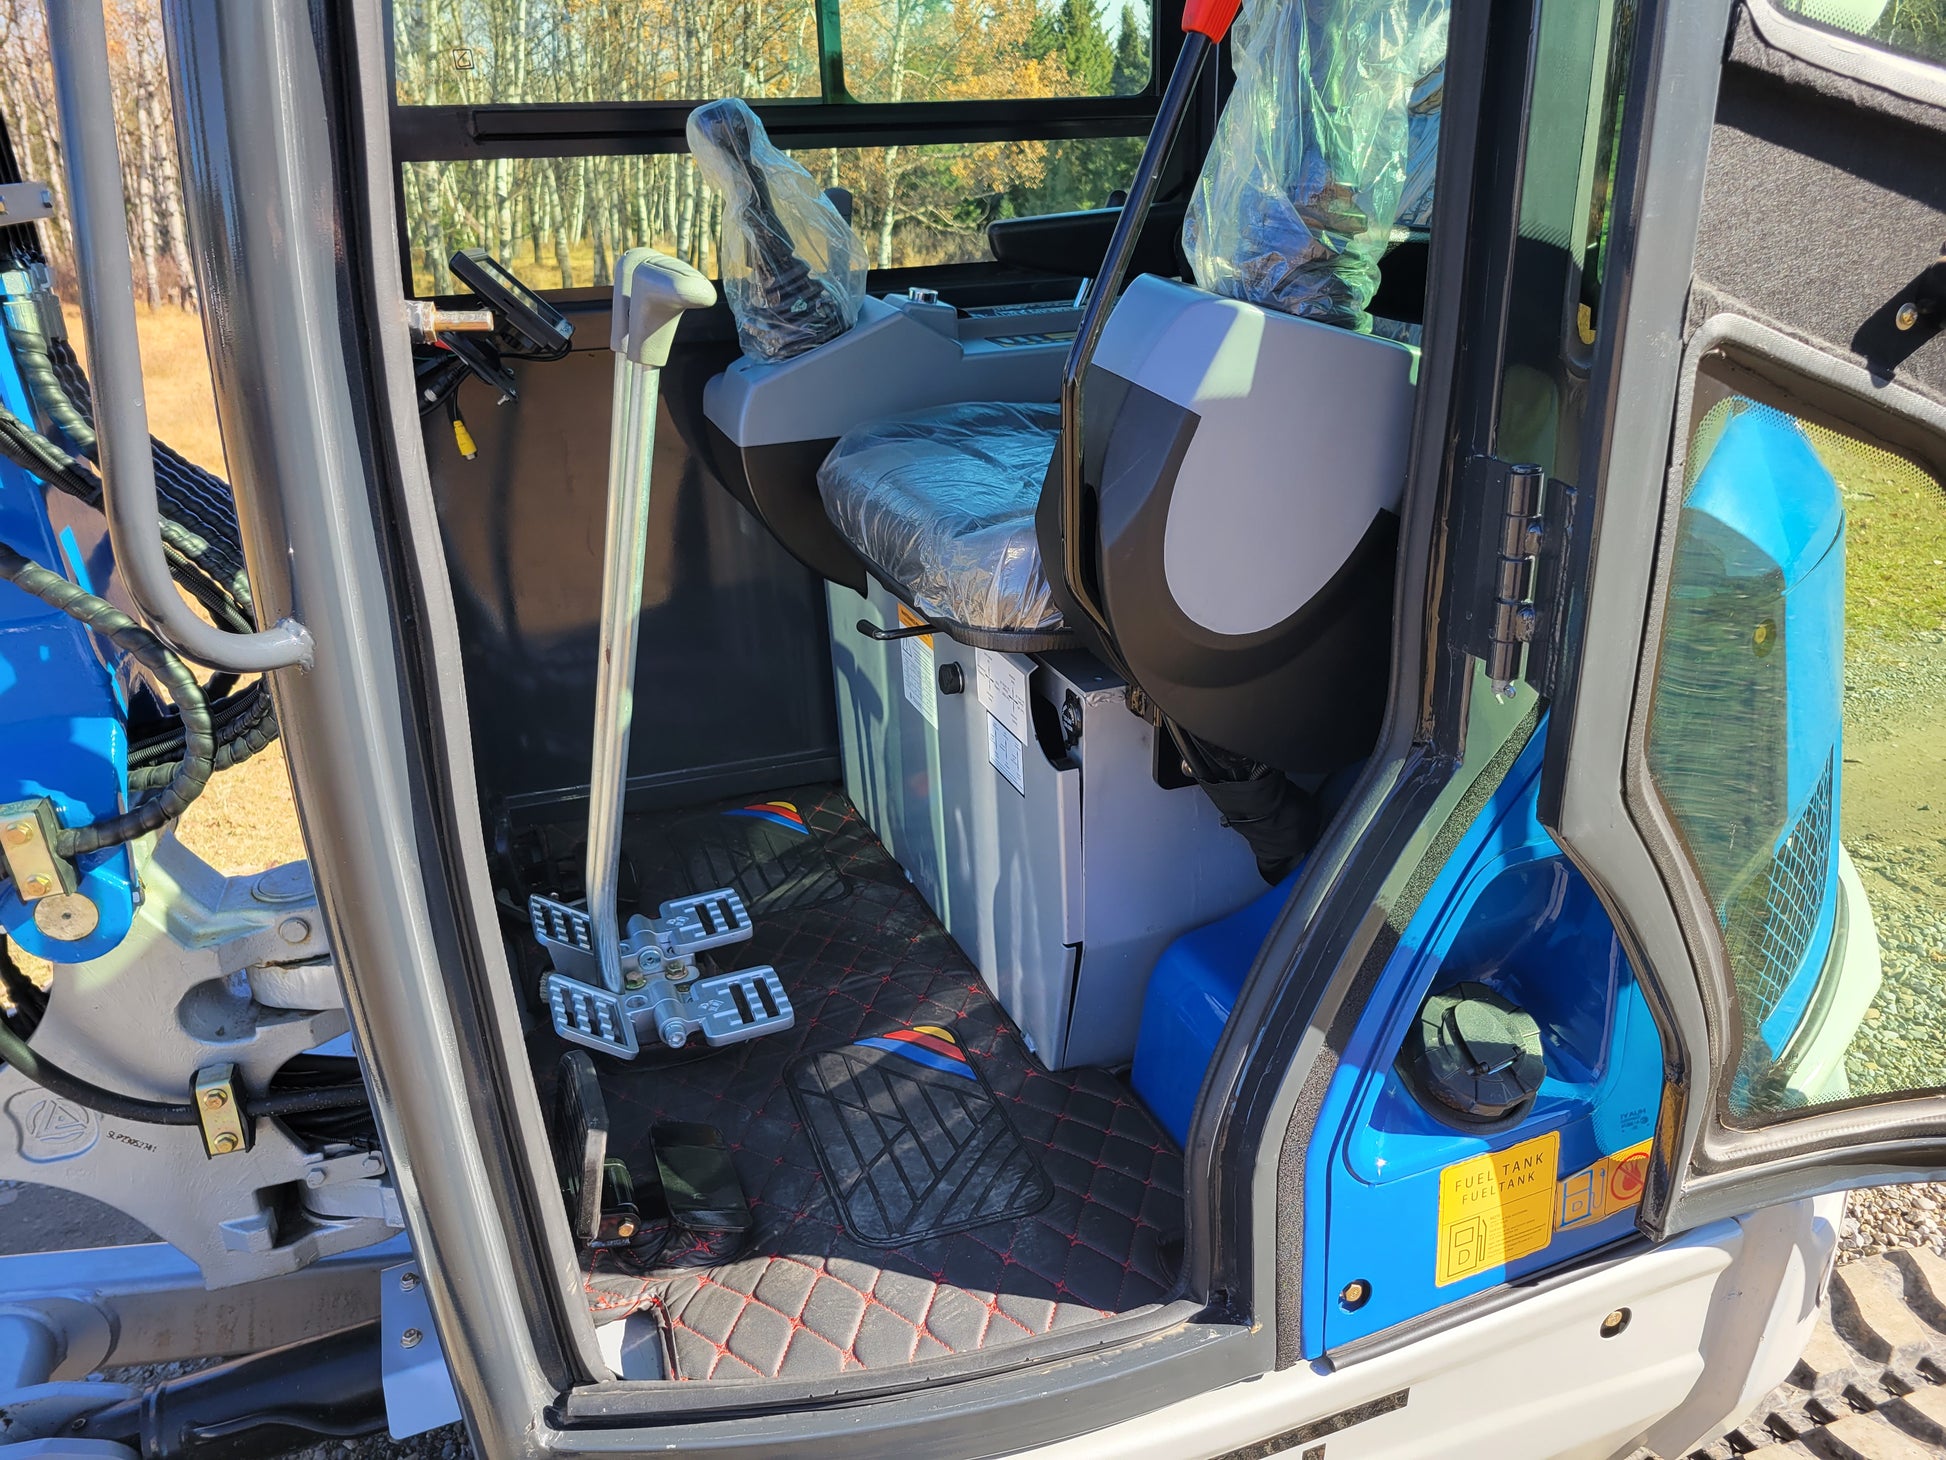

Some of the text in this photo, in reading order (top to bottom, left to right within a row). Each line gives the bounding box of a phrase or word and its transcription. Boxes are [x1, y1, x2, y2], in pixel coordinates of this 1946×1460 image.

[1455, 1152, 1544, 1192] FUEL TANK
[1458, 1249, 1470, 1265] D
